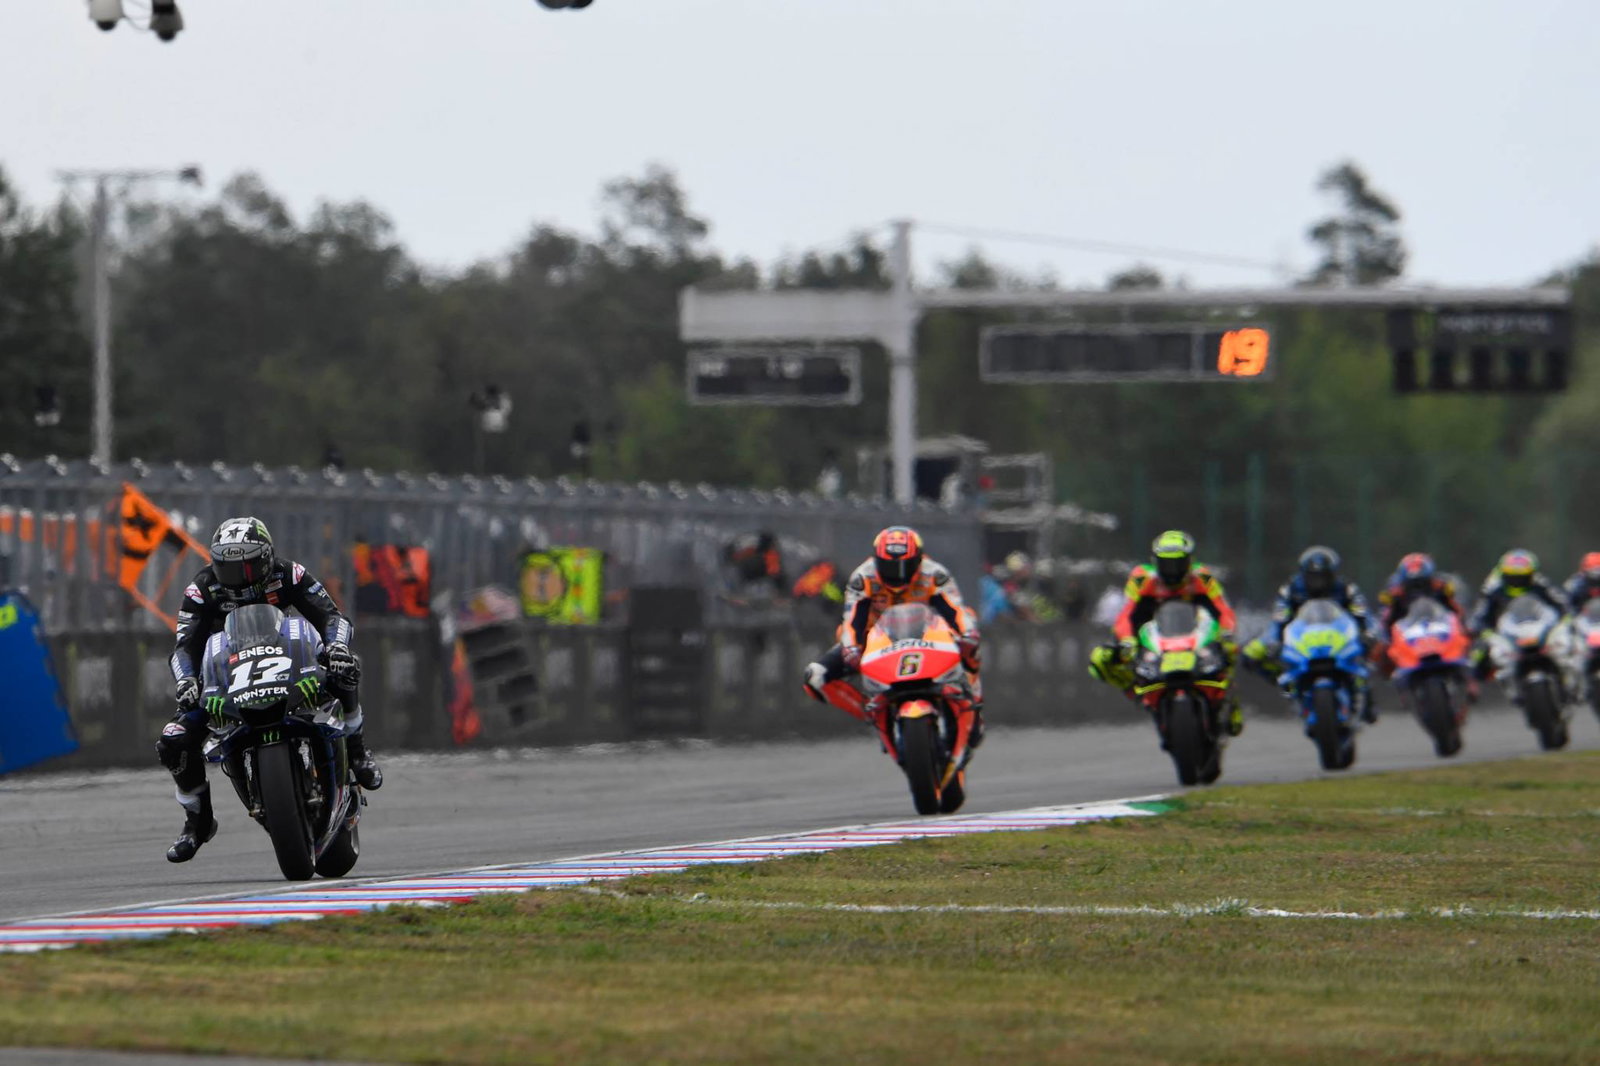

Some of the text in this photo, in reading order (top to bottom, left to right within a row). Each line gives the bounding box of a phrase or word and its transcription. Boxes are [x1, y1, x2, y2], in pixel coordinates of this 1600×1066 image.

[1217, 328, 1270, 376] 19
[238, 645, 284, 661] ENEOS
[898, 653, 922, 677] 6
[227, 656, 293, 694] 12
[233, 686, 289, 704] MONSTER
